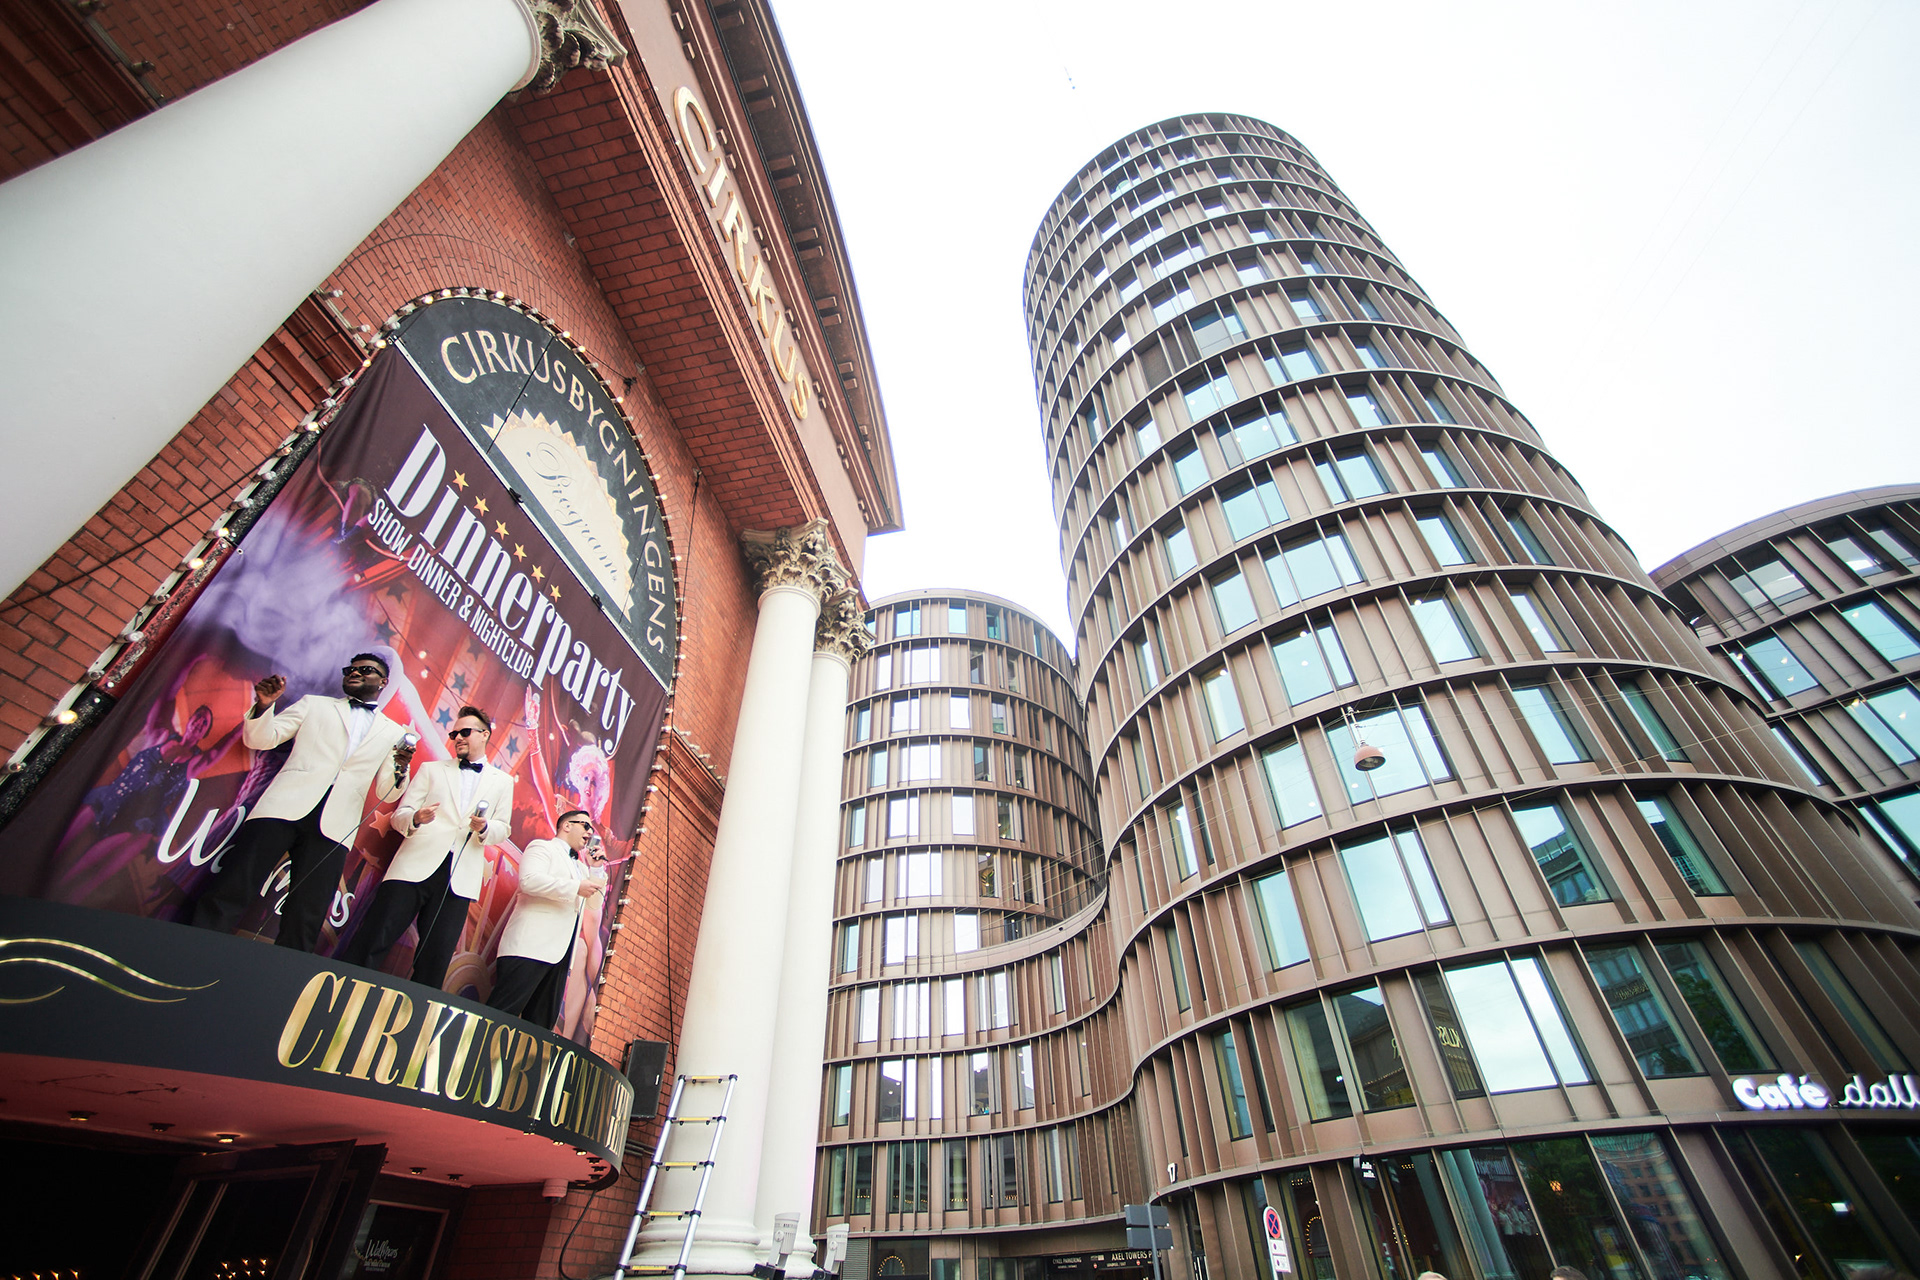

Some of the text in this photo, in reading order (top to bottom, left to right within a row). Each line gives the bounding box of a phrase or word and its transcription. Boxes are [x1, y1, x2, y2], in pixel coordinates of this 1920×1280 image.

[673, 85, 812, 421] CIRKUS
[367, 498, 535, 680] SHOW, DINNER & NIGHTCLUB
[383, 423, 636, 755] Dinnerparty
[440, 329, 667, 655] CIRKUSBYGNINGENS
[1732, 1073, 1830, 1110] Café
